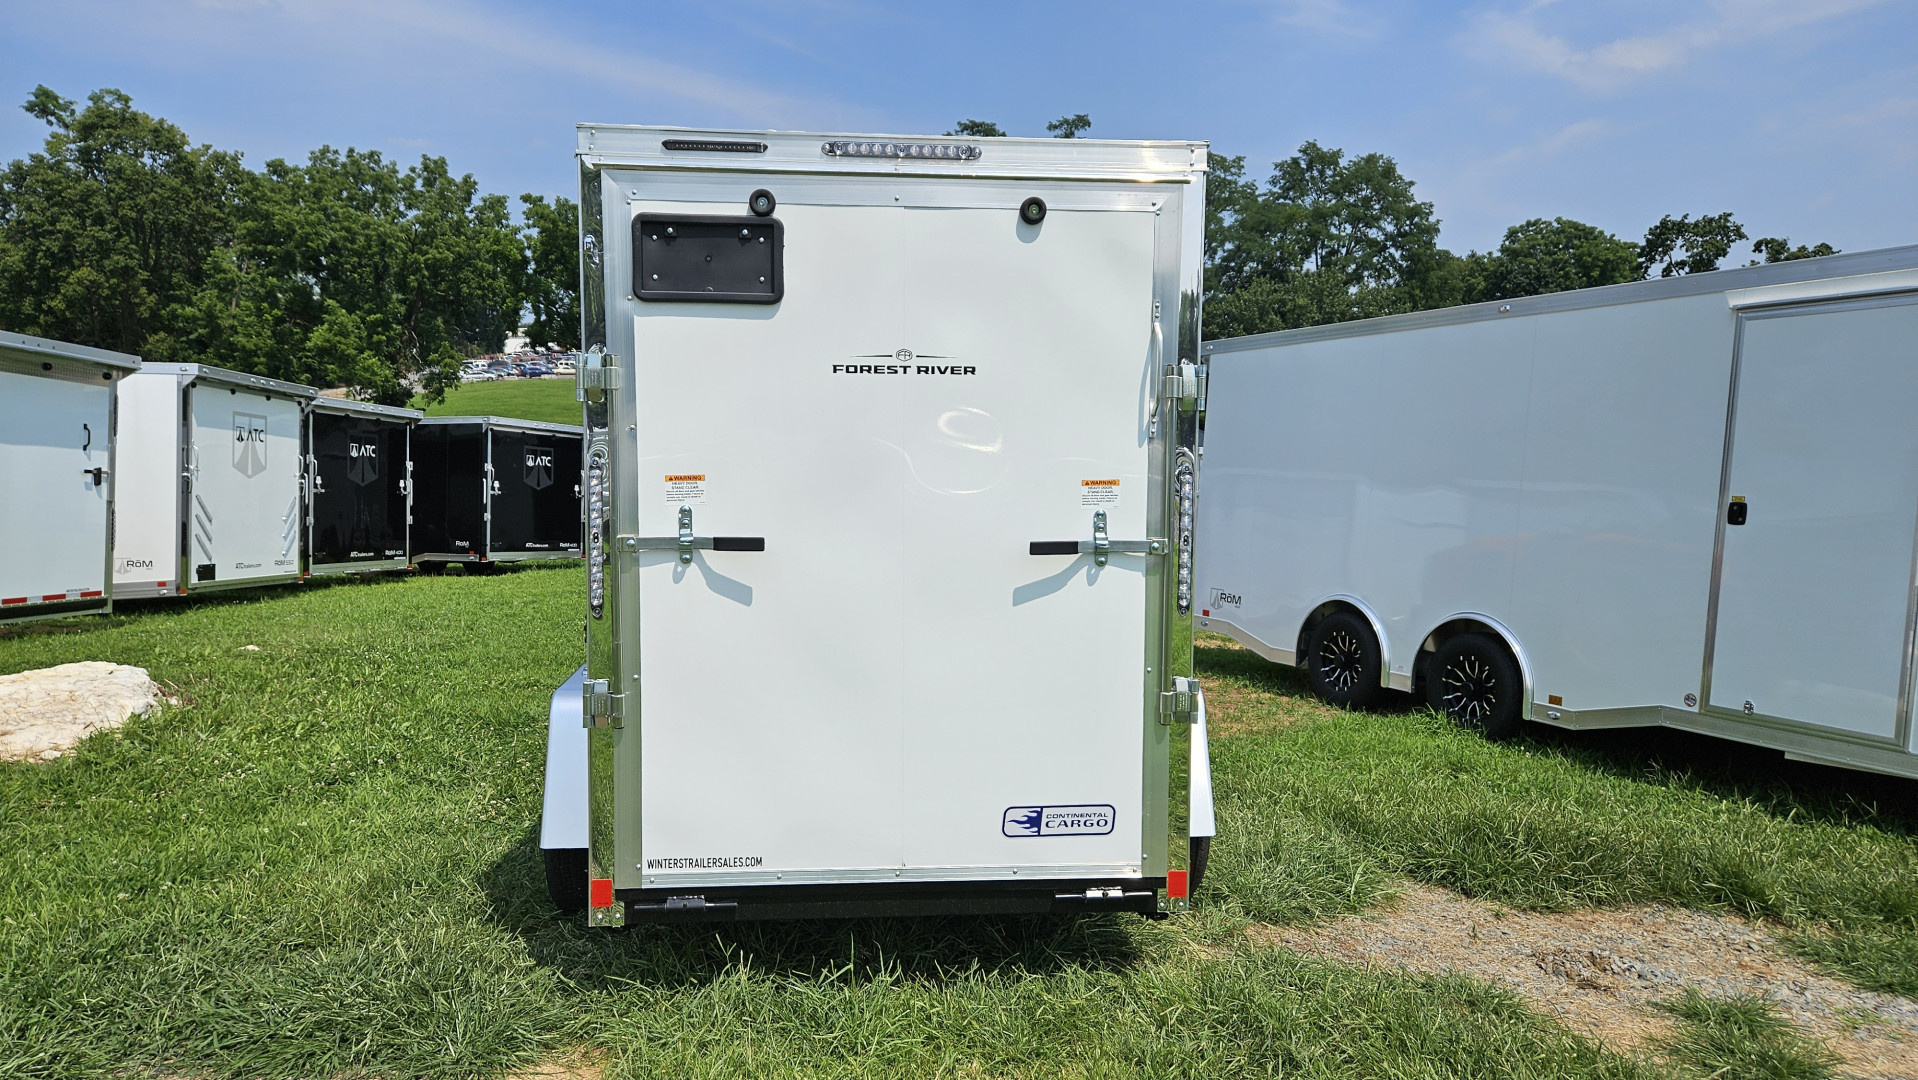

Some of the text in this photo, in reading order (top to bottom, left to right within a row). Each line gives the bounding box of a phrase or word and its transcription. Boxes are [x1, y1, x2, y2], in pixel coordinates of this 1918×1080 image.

[832, 364, 976, 375] FOREST RIVER
[246, 428, 264, 443] ATC
[360, 444, 376, 457] ATC
[535, 456, 552, 466] ATC
[1045, 818, 1108, 828] CARGO
[647, 857, 763, 869] WINTERSTRAILERSALES.COM
